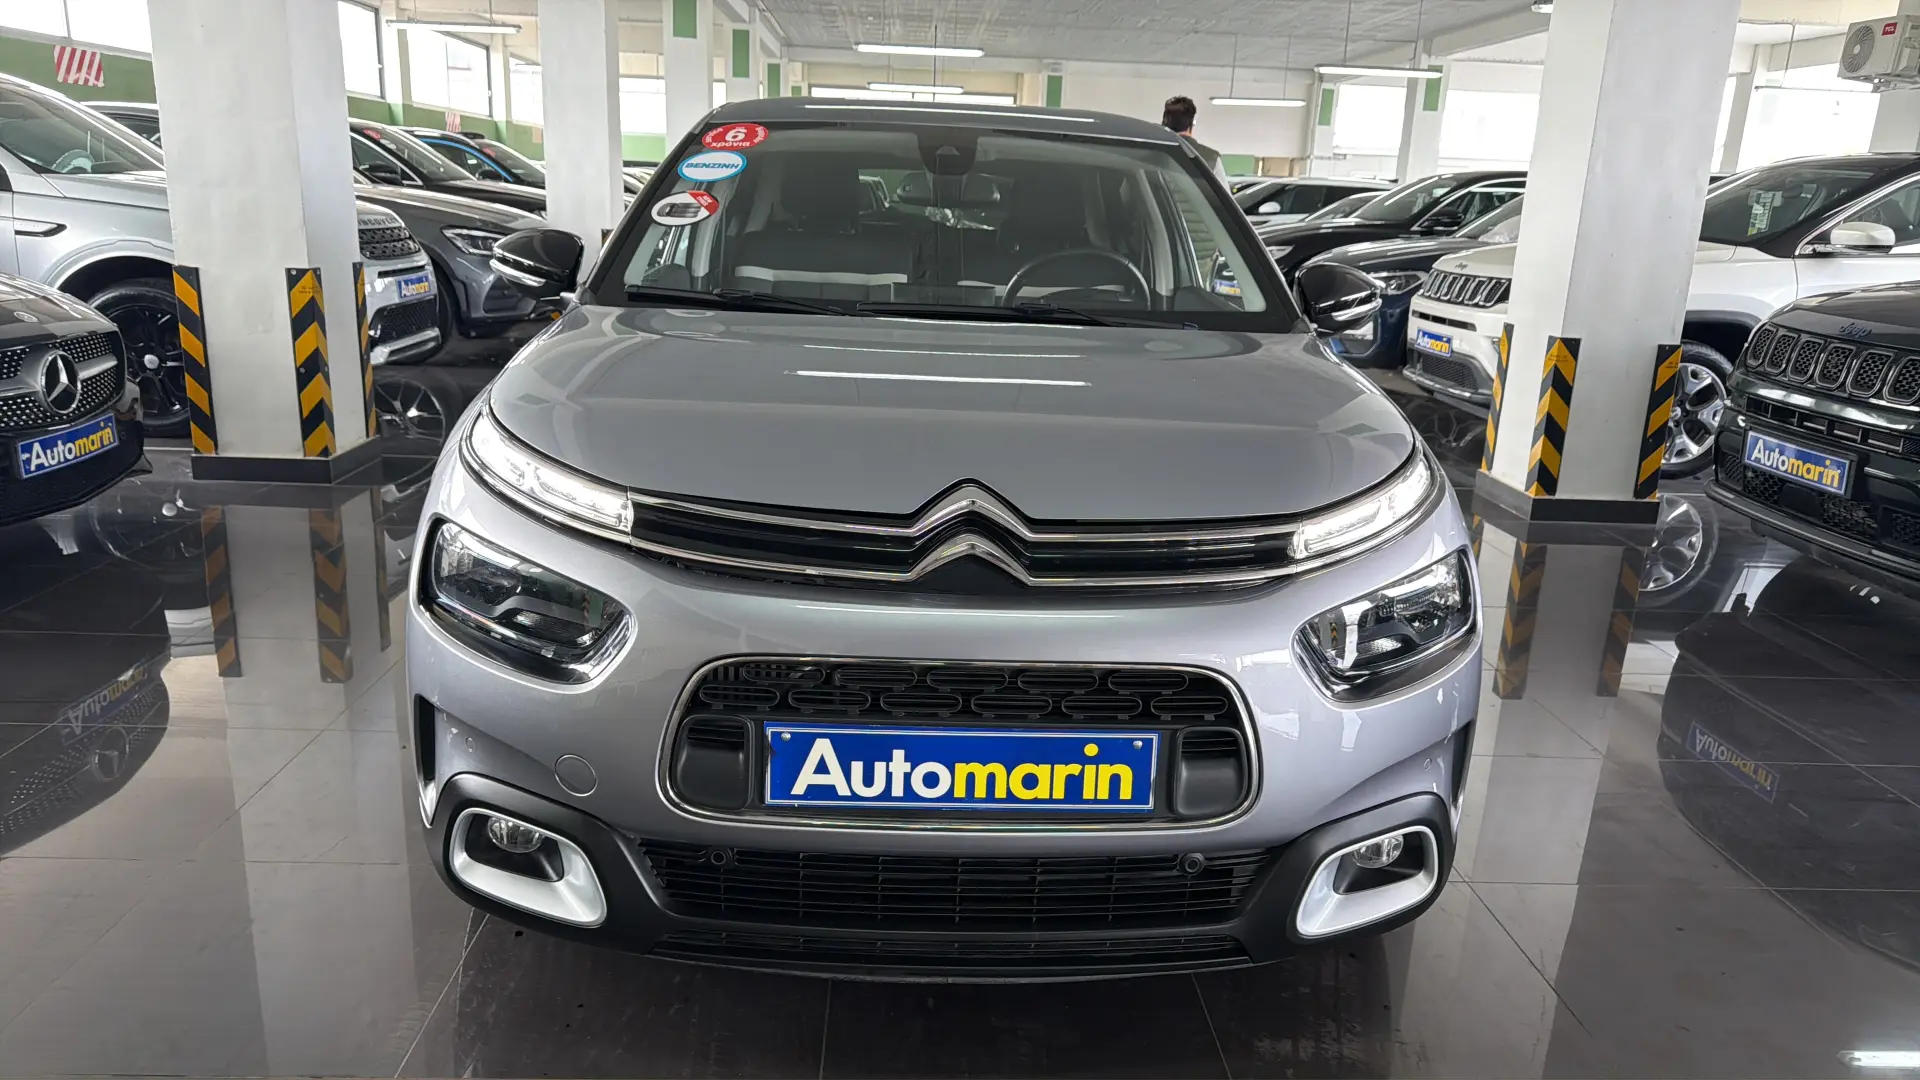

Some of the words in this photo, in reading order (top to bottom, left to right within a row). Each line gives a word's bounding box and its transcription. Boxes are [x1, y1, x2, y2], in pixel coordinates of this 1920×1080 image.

[725, 128, 747, 142] 6
[1416, 331, 1450, 353] Automarin
[30, 421, 114, 471] Automarin
[1750, 439, 1840, 488] Automarin
[790, 738, 1133, 800] Automarin
